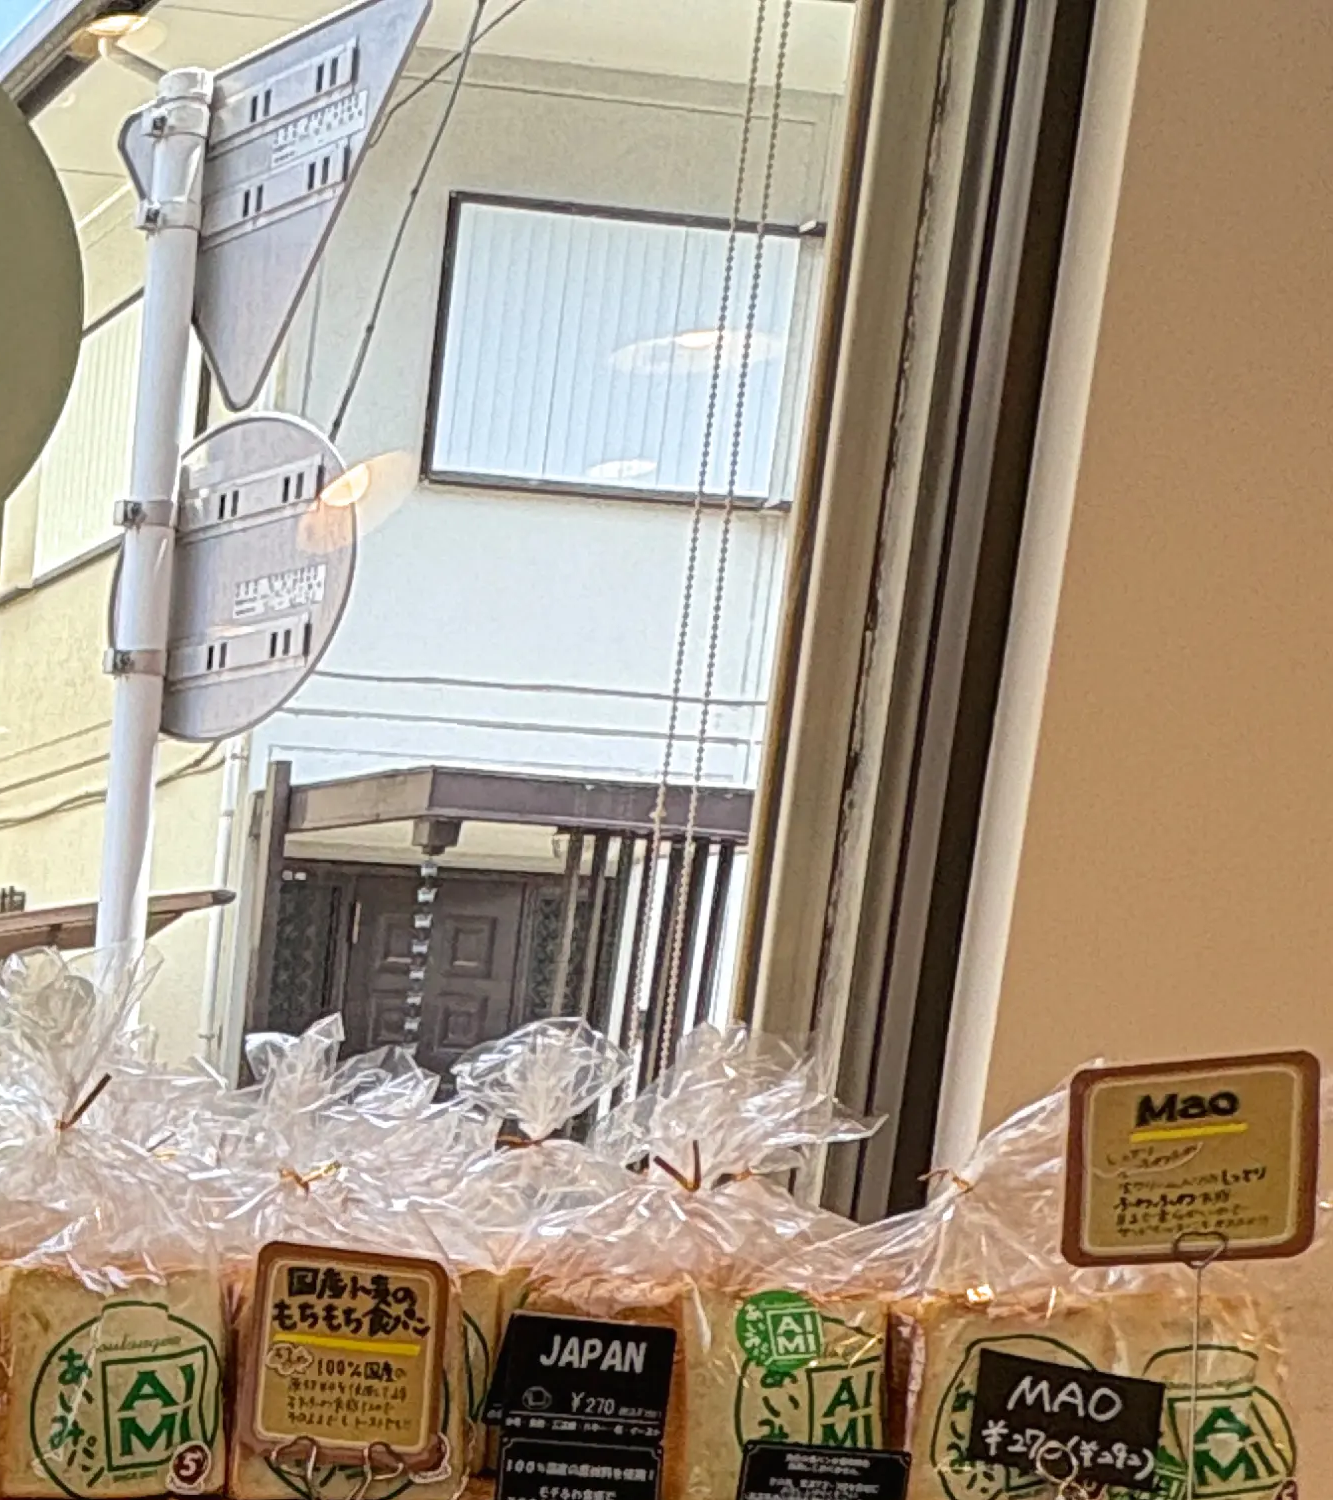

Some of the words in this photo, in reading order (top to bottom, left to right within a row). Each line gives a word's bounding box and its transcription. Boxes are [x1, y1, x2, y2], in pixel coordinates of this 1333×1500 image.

[1135, 1092, 1240, 1128] Mao
[286, 1266, 417, 1308] 国産小麦の
[271, 1298, 431, 1338] もちもち食パン
[776, 1313, 815, 1335] AI
[539, 1334, 648, 1375] JAPAN
[775, 1334, 818, 1355] MI
[118, 1363, 196, 1412] AI
[822, 1371, 876, 1419] AI
[1006, 1376, 1123, 1422] MAO
[118, 1406, 192, 1457] MI
[1194, 1441, 1280, 1486] MI
